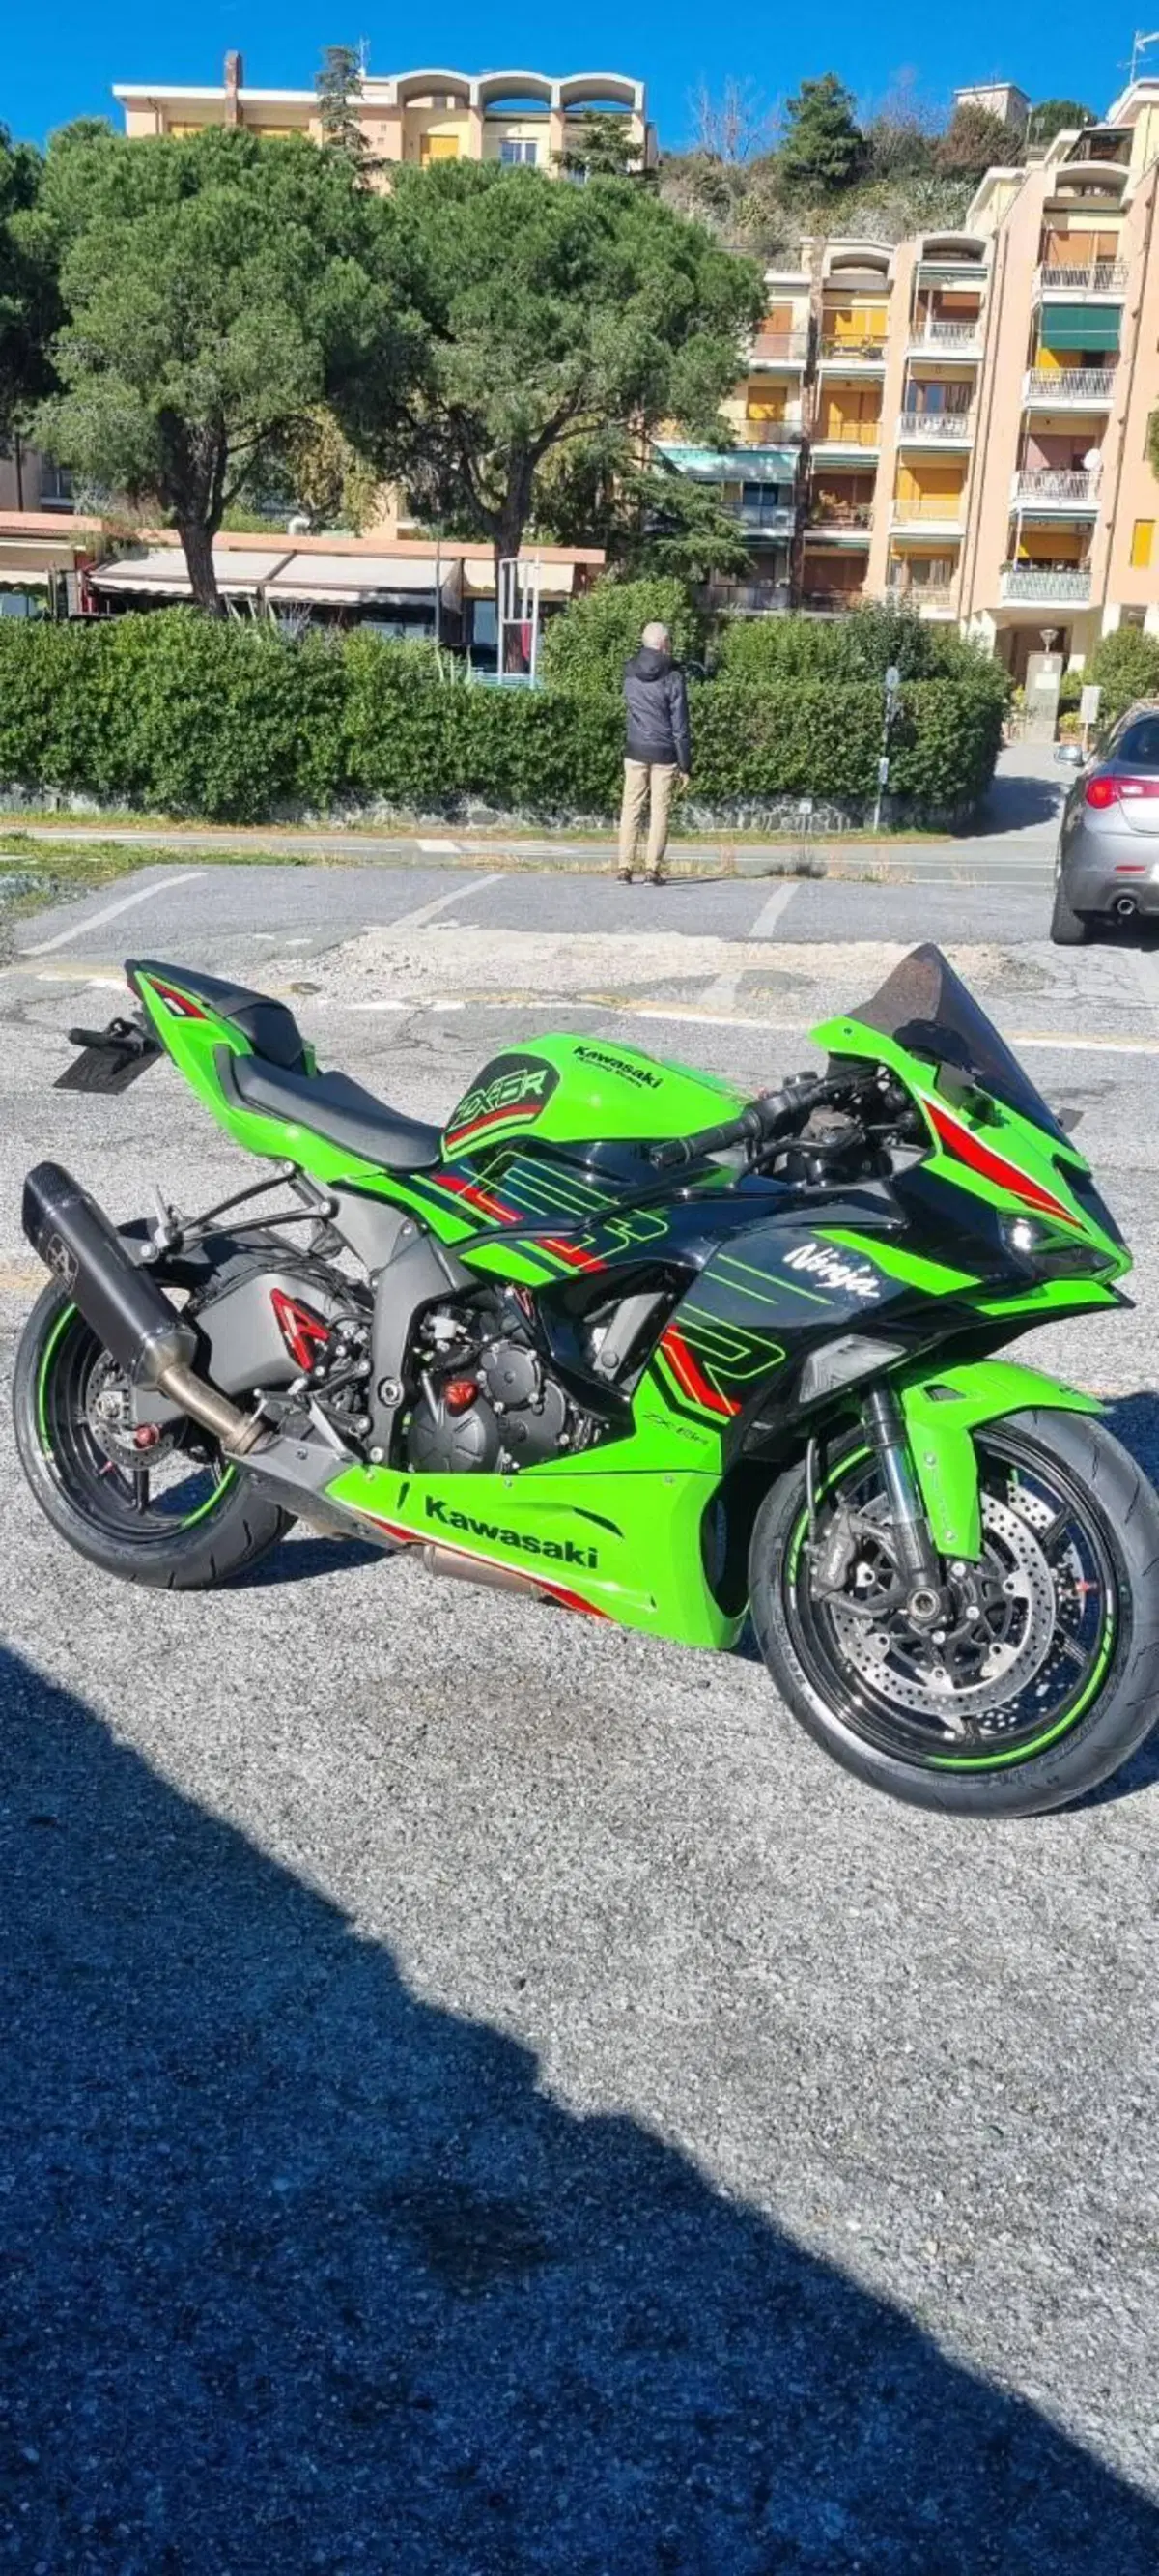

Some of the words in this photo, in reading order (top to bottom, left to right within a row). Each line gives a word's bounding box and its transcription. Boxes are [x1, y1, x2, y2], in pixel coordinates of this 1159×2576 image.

[573, 1045, 664, 1089] Kawasaki
[782, 1243, 881, 1298] Ninja
[425, 1495, 599, 1570] Kawasaki
